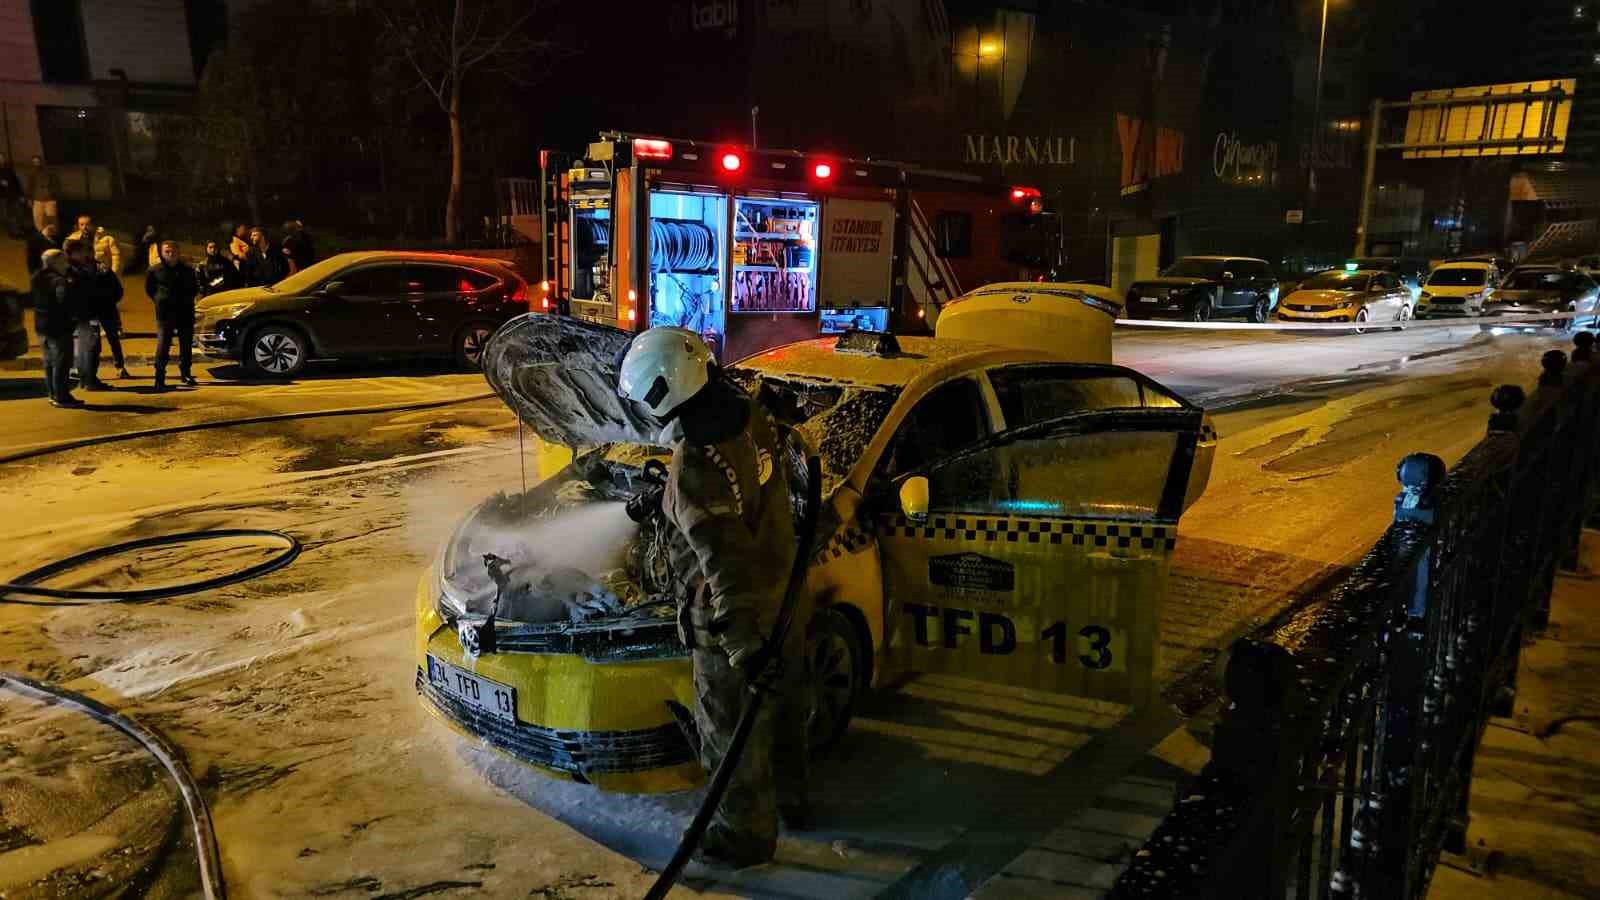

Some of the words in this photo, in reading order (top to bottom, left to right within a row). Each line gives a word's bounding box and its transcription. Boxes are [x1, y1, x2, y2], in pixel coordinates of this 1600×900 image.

[964, 135, 1076, 164] MARNALI
[904, 603, 1016, 655] TFD
[1042, 621, 1112, 669] 13
[456, 673, 480, 700] TFD
[494, 689, 510, 713] 13
